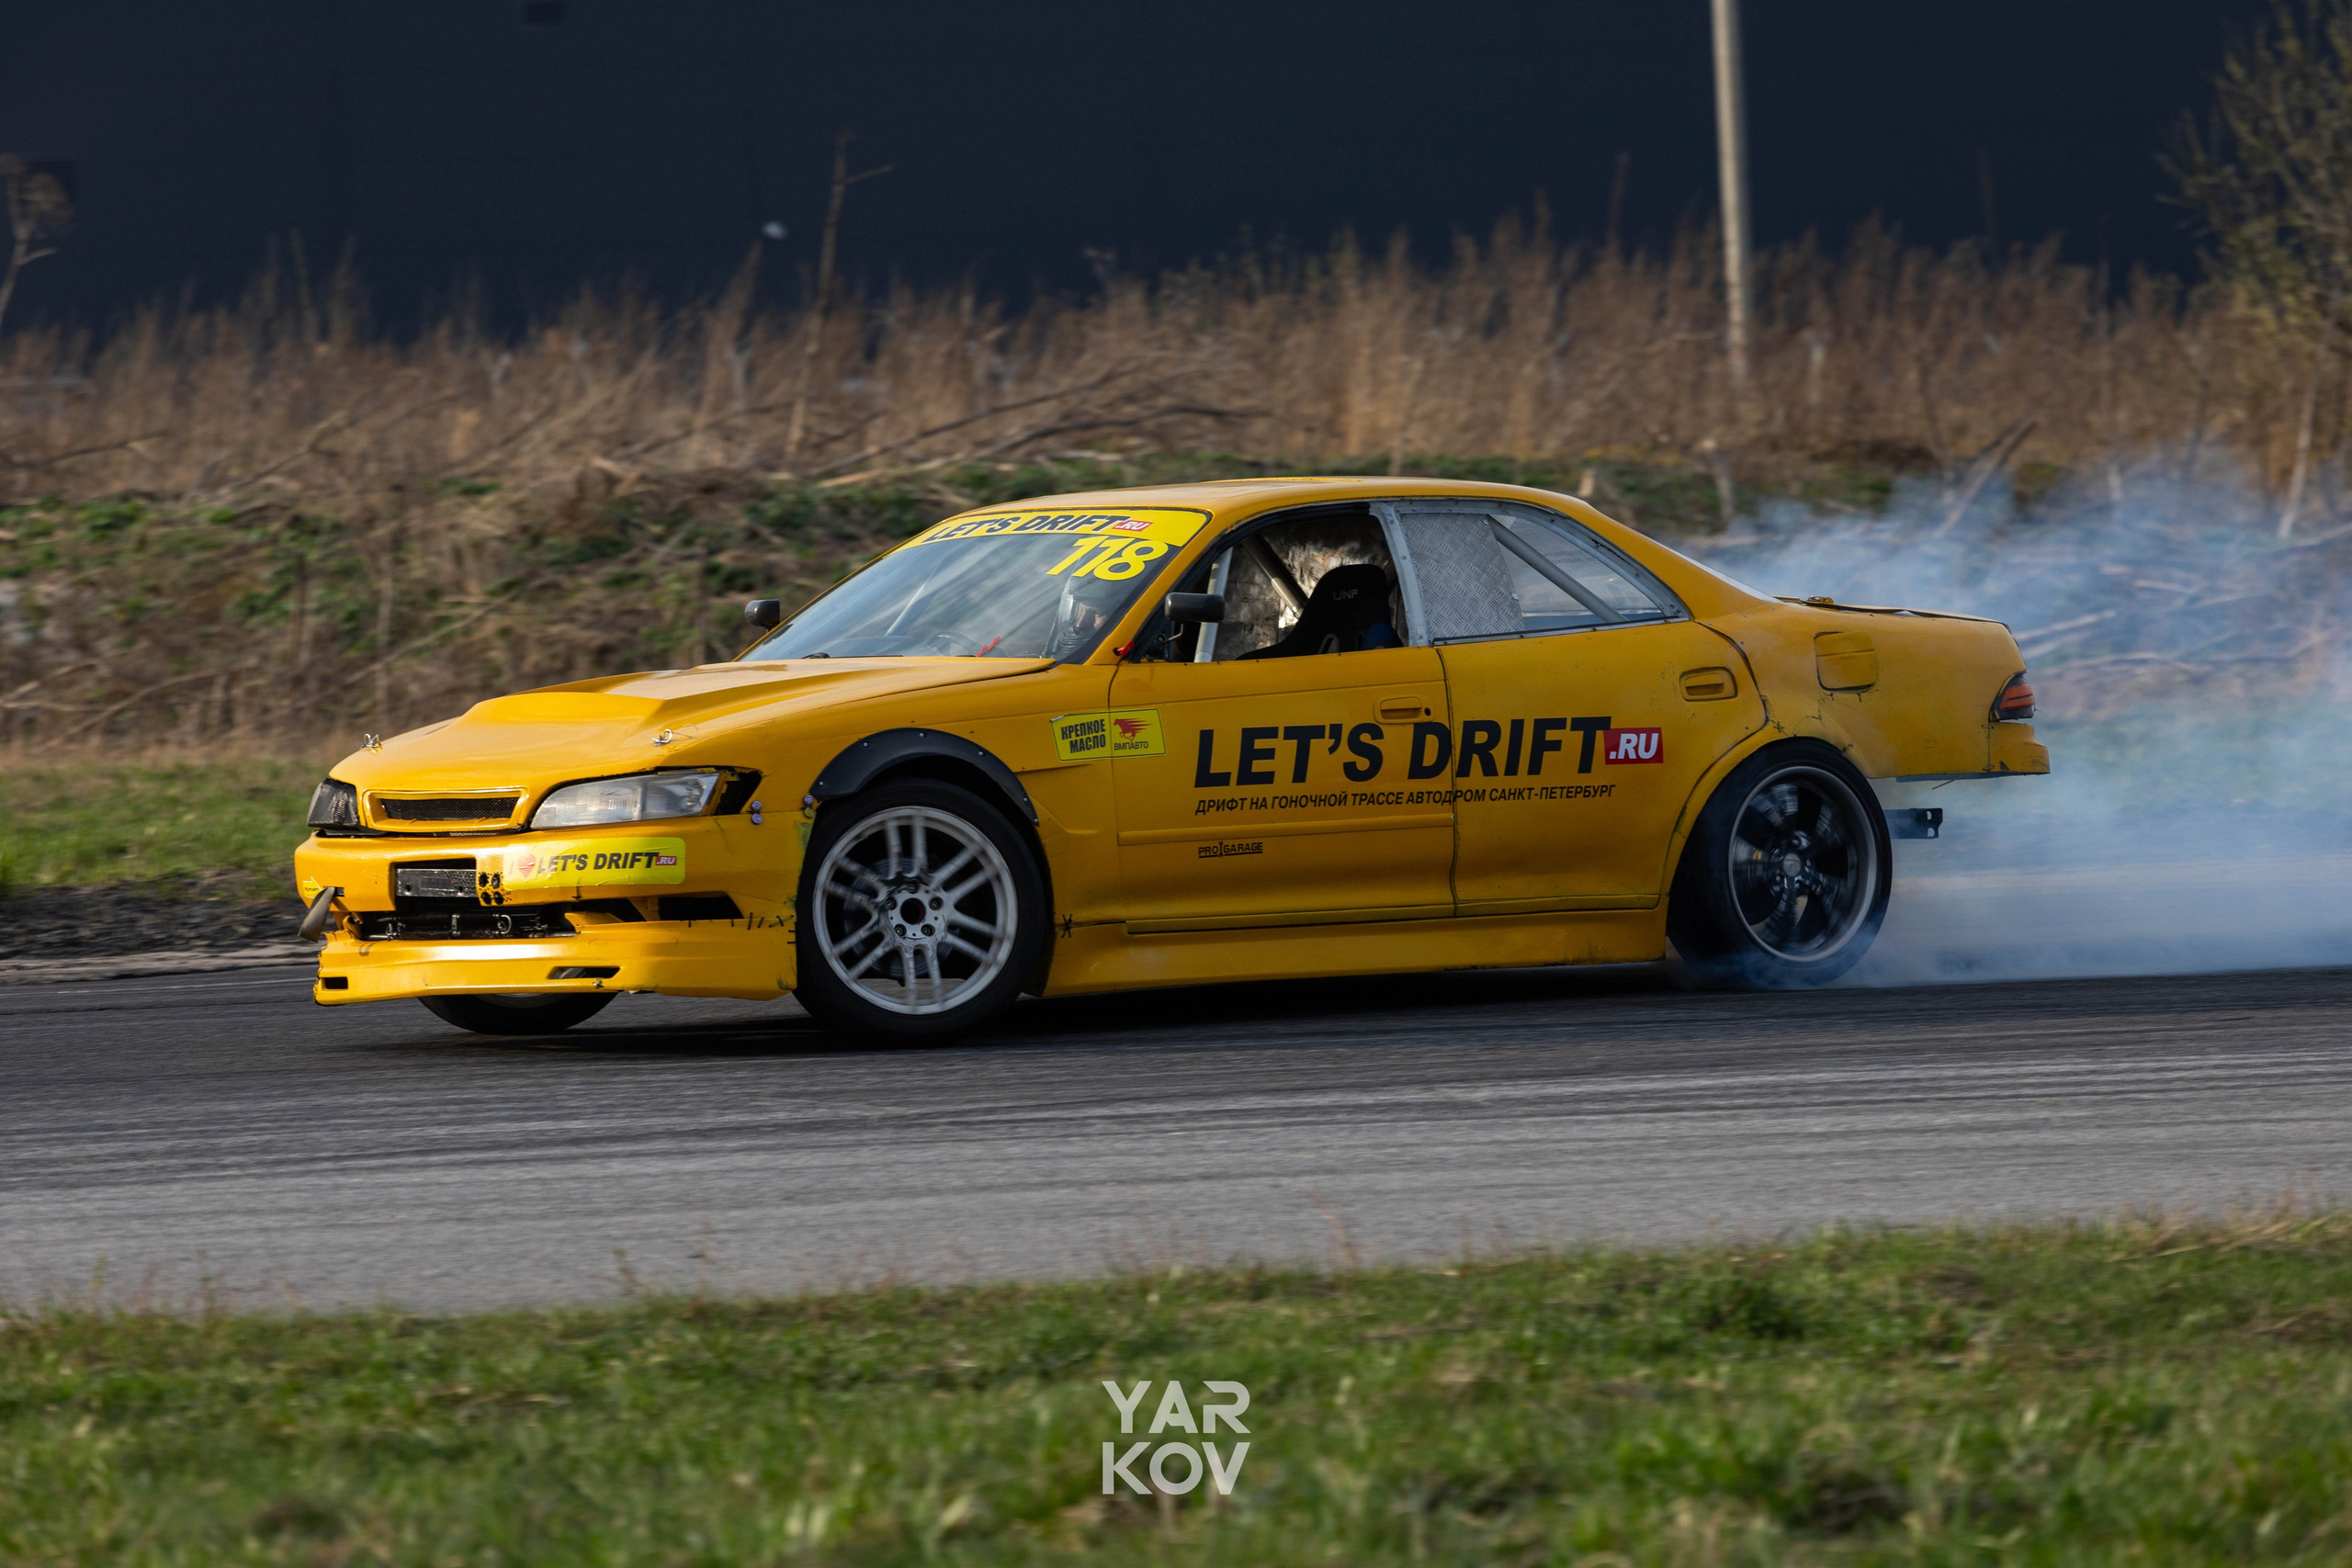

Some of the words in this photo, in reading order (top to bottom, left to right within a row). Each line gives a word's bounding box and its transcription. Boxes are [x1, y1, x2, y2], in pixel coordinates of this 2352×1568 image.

[926, 515, 1021, 542] LET'S
[1046, 536, 1169, 581] 118
[1060, 719, 1105, 740] КРЕПКОЕ
[1069, 734, 1106, 753] МАСЛО
[1114, 741, 1149, 750] ВМПАВТО
[1194, 722, 1385, 788] LET'S
[1195, 797, 1247, 816] ДРИФТ
[1250, 796, 1268, 810] НА
[1272, 791, 1349, 808] ГОНОЧНОЙ
[1351, 792, 1404, 806] ТРАССЕ
[1406, 788, 1486, 807] АВТОДРОМ
[1489, 784, 1616, 802] САНКТ-ПЕТЕРБУРГ
[537, 853, 588, 874] LET'S
